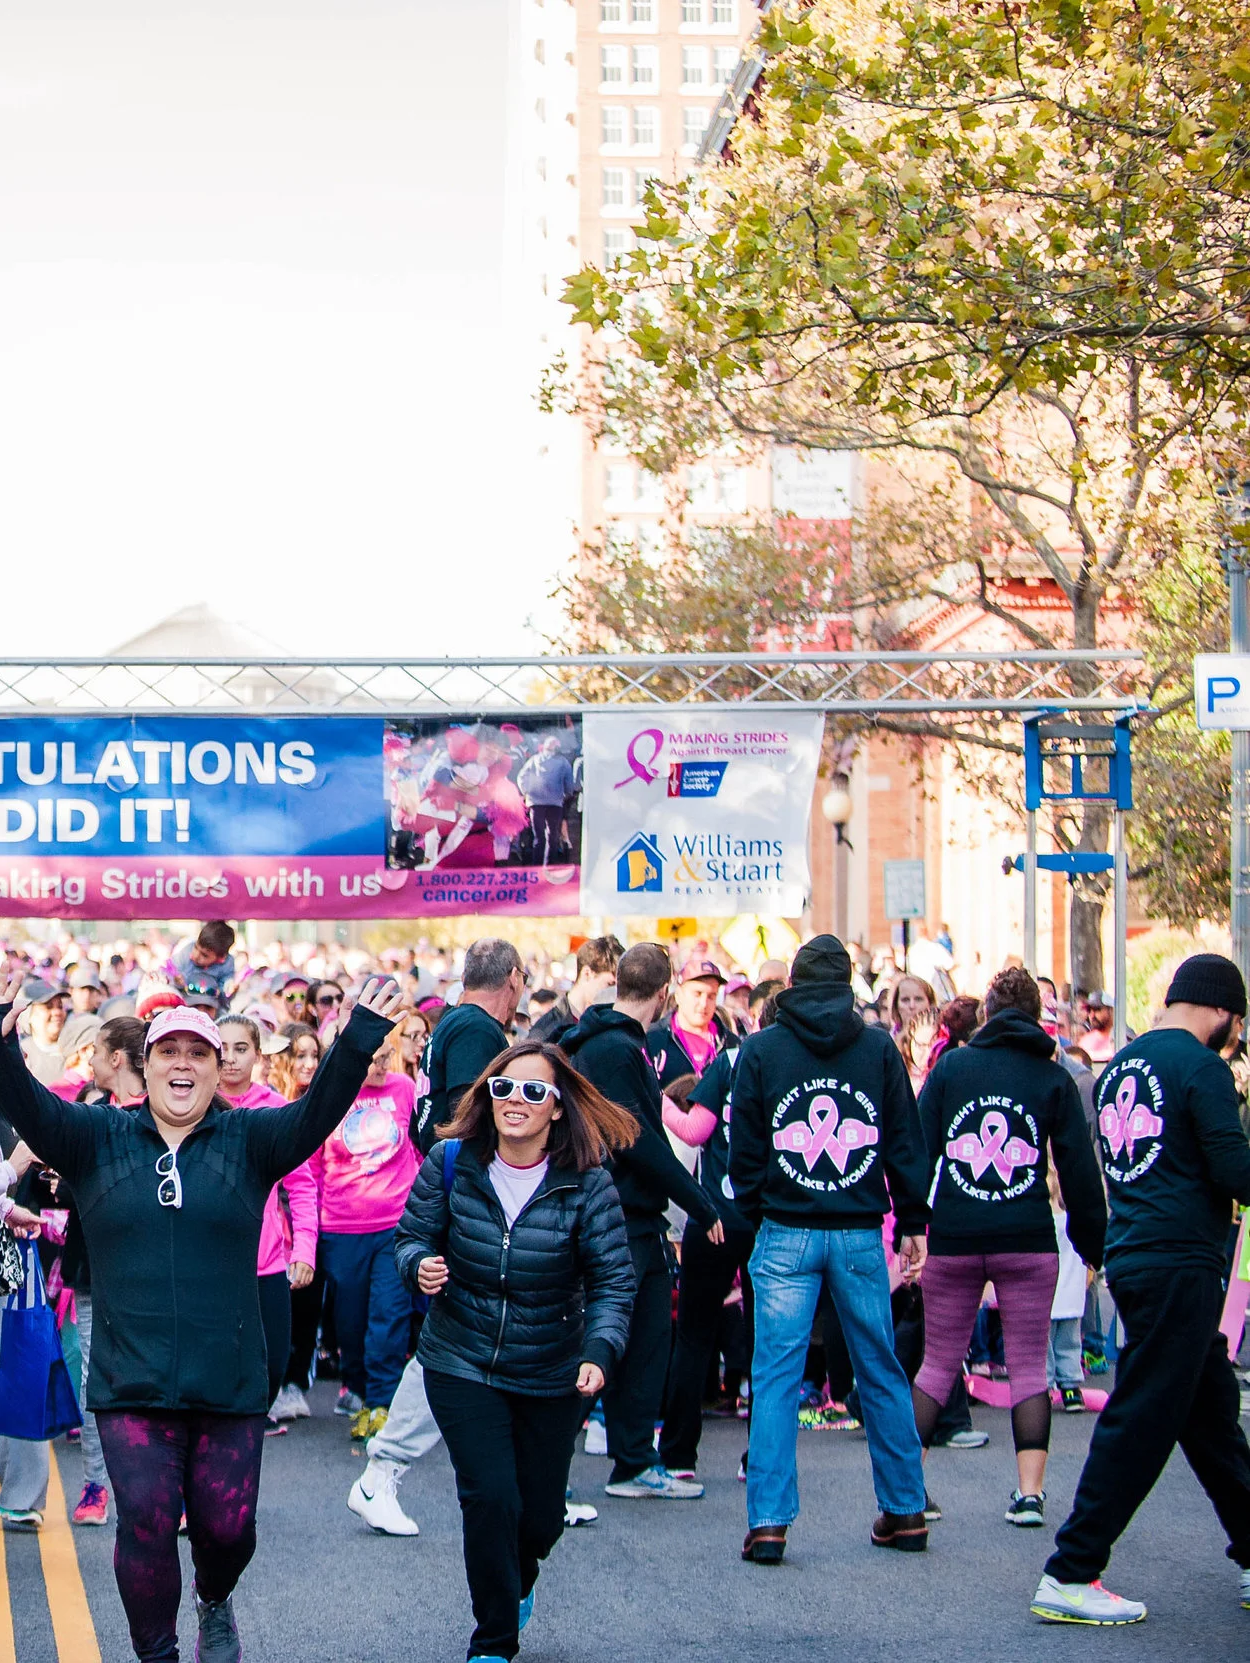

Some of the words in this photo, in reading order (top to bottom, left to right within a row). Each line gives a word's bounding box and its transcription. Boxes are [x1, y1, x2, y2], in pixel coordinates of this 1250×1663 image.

[1208, 677, 1240, 712] P
[669, 733, 728, 744] MAKING
[734, 732, 788, 743] STRIDES
[669, 747, 709, 757] Against
[713, 747, 747, 755] Breast
[750, 747, 787, 755] Cancer
[683, 769, 720, 777] American
[120, 799, 190, 842] IT!
[673, 834, 783, 857] Williams
[674, 852, 704, 882] &
[706, 860, 784, 881] Stuart
[101, 868, 229, 899] Strides
[244, 867, 324, 897] with
[339, 872, 381, 897] us
[416, 872, 539, 887] 1.800.227.2345
[423, 887, 528, 904] cancer.org
[674, 887, 713, 895] REAL
[726, 887, 782, 895] ESTATE
[1121, 1058, 1145, 1071] LIKE
[1141, 1065, 1151, 1076] A
[1148, 1076, 1164, 1112] GIRL
[772, 1087, 800, 1128] FIGHT
[803, 1078, 838, 1092] LIKE
[840, 1083, 851, 1094] A
[854, 1090, 878, 1123] GIRL
[948, 1100, 975, 1138] FIGHT
[979, 1095, 1012, 1108] LIKE
[1013, 1104, 1023, 1115] A
[792, 1132, 805, 1146] B
[845, 1129, 858, 1143] B
[962, 1143, 975, 1156] B
[777, 1154, 797, 1179] WIN
[796, 1173, 825, 1191] LIKE
[827, 1181, 838, 1192] A
[838, 1149, 877, 1188] WOMAN
[962, 1181, 990, 1201] LIKE
[991, 1191, 1002, 1201] A
